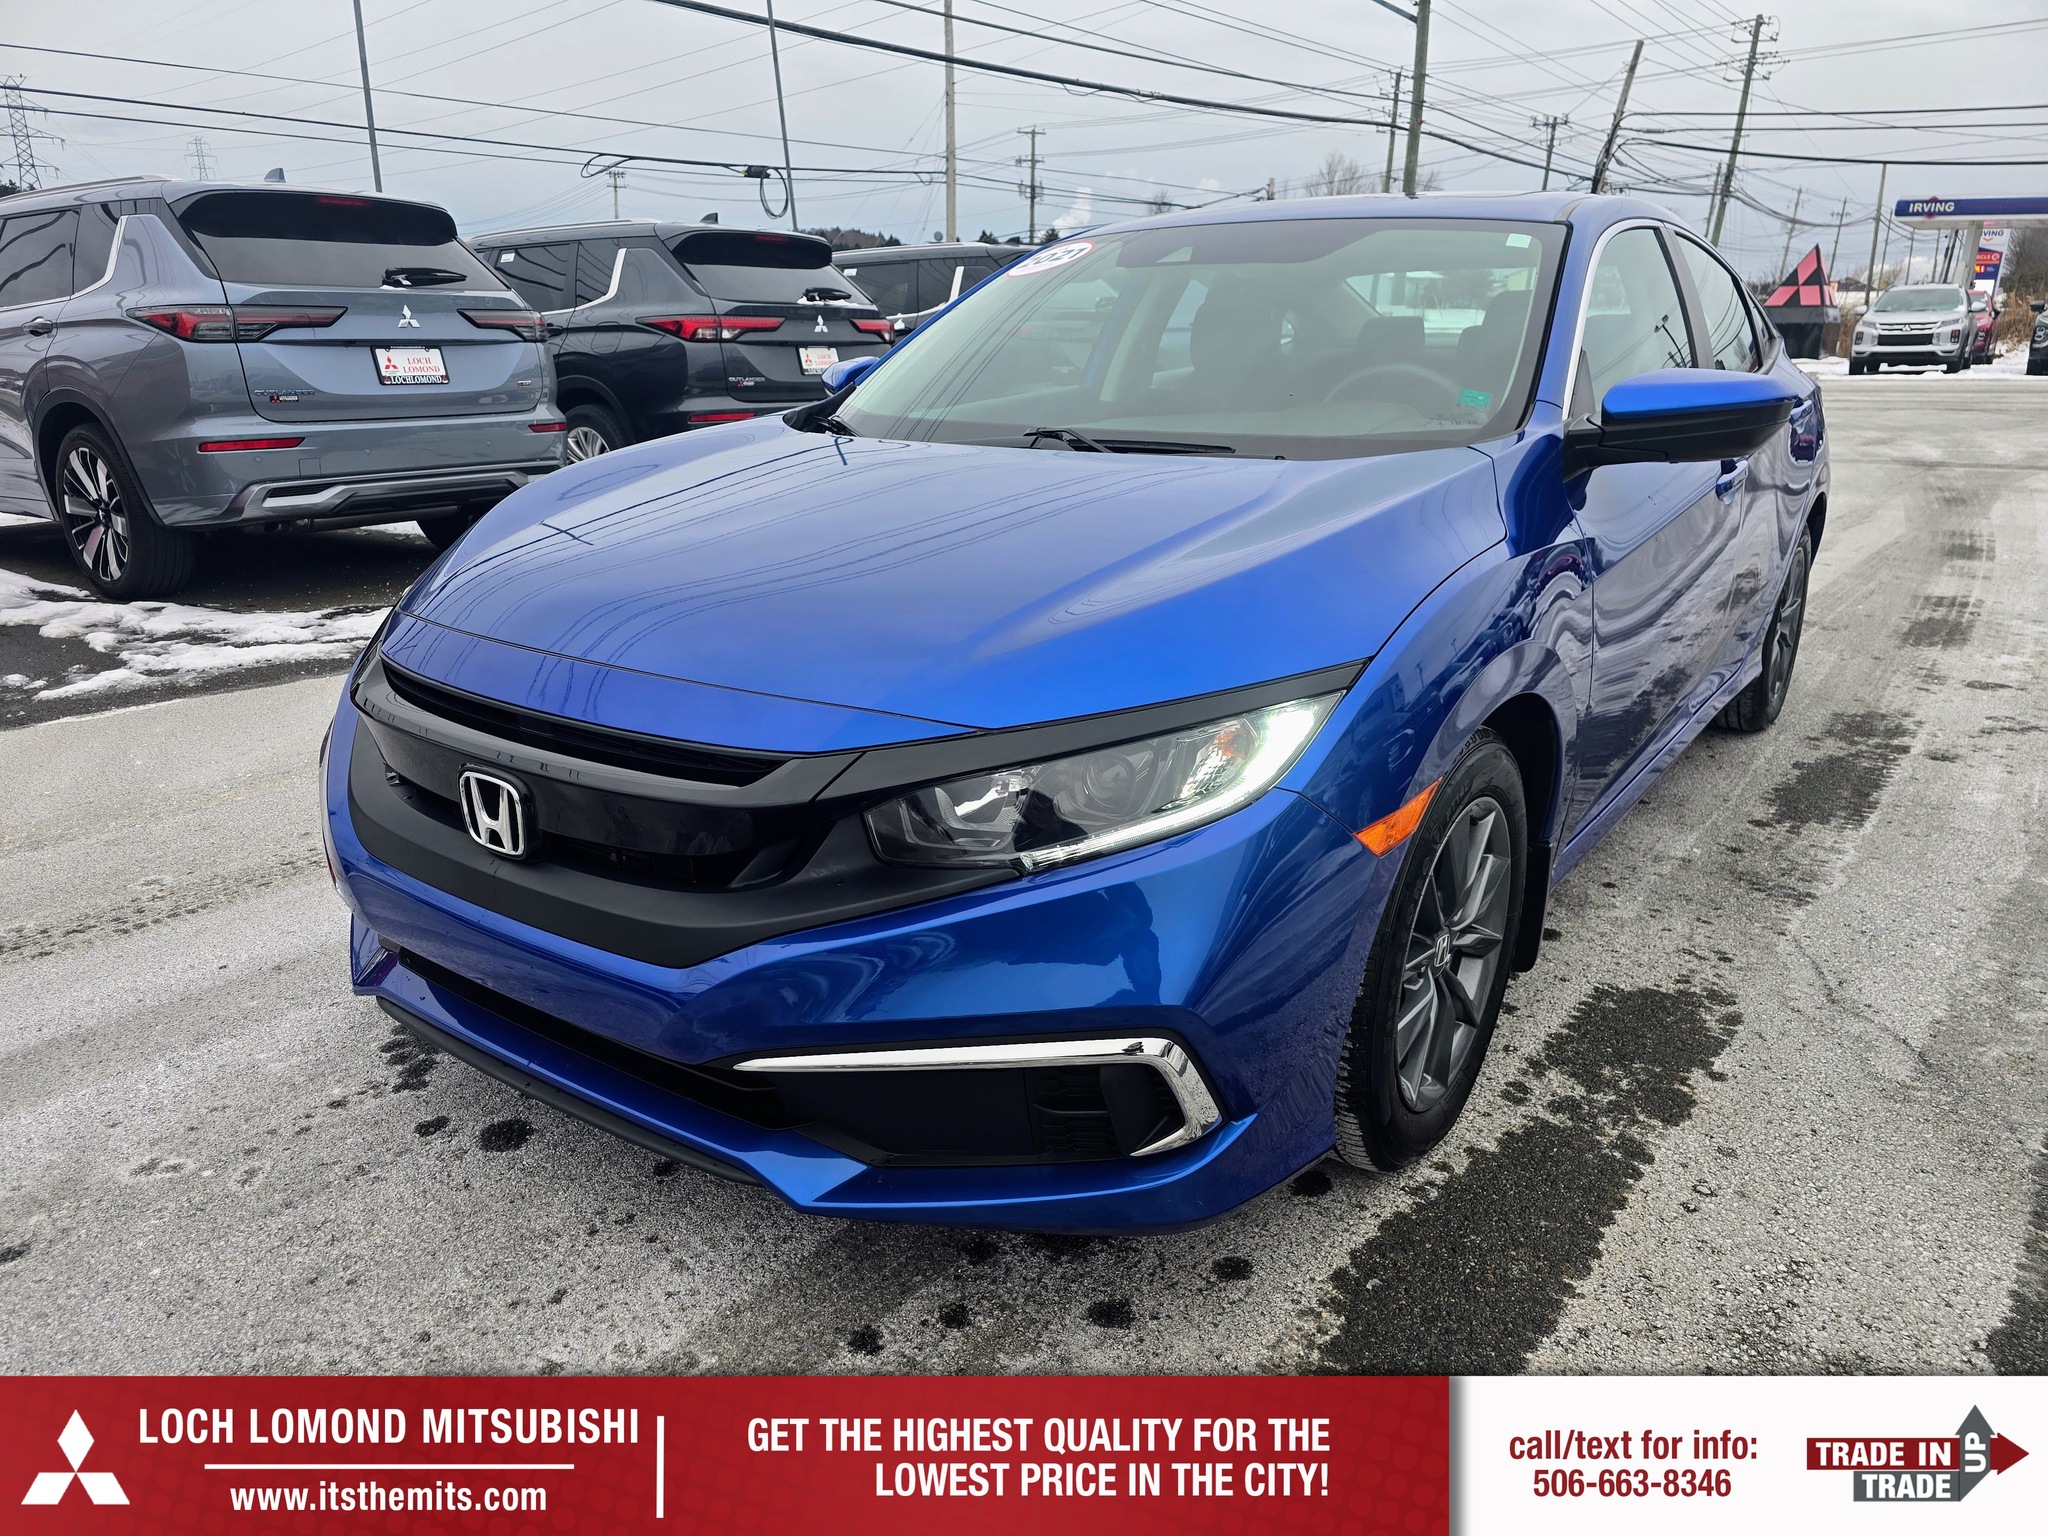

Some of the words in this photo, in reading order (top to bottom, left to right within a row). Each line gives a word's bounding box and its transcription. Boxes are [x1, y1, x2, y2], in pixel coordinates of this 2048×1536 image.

[1908, 202, 1955, 213] IRVING
[1981, 229, 2005, 237] VING
[407, 357, 432, 365] LOCH
[403, 366, 441, 374] LOMOND
[391, 375, 442, 384] LOCHLOMOND
